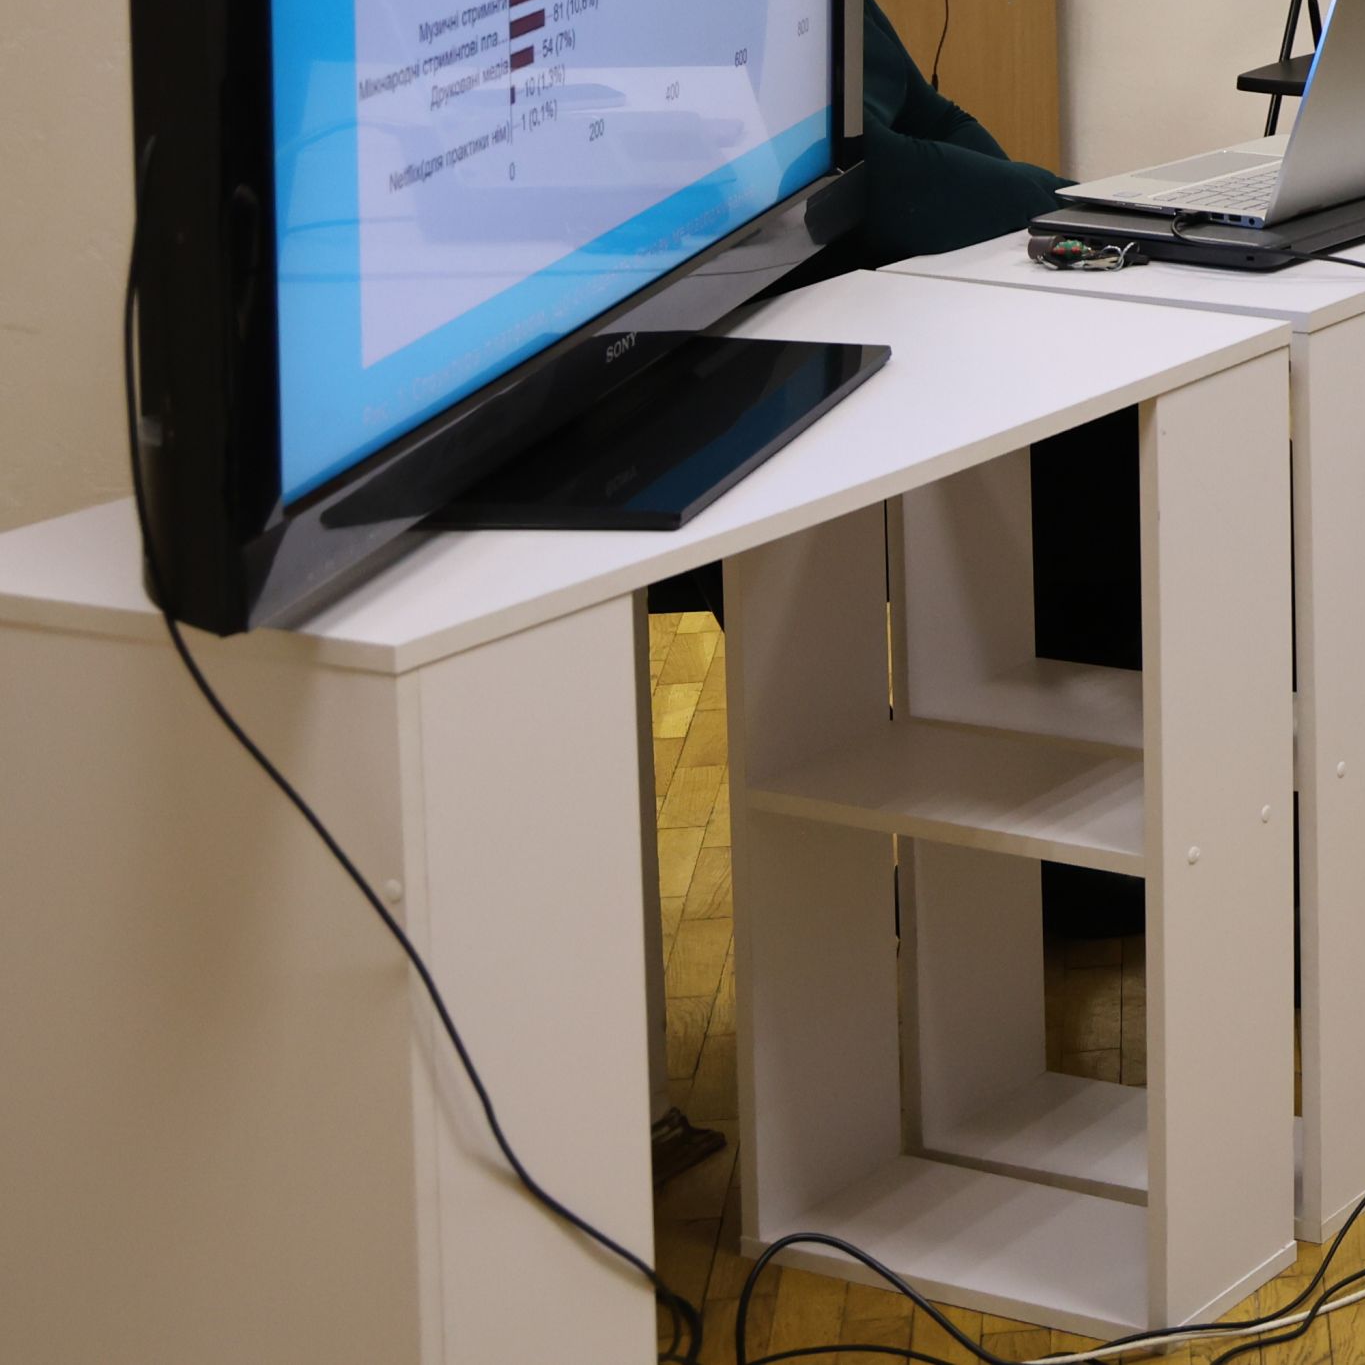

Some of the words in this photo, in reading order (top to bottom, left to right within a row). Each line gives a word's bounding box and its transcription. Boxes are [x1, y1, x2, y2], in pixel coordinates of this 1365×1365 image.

[553, 2, 564, 22] 81
[418, 13, 460, 43] Музичні
[555, 28, 576, 58] (7%)
[423, 35, 478, 76] стримінгові
[430, 72, 481, 112] Друковані
[482, 57, 509, 84] медіа
[588, 118, 605, 142] 200
[508, 162, 516, 181] 0
[605, 332, 637, 363] SONY
